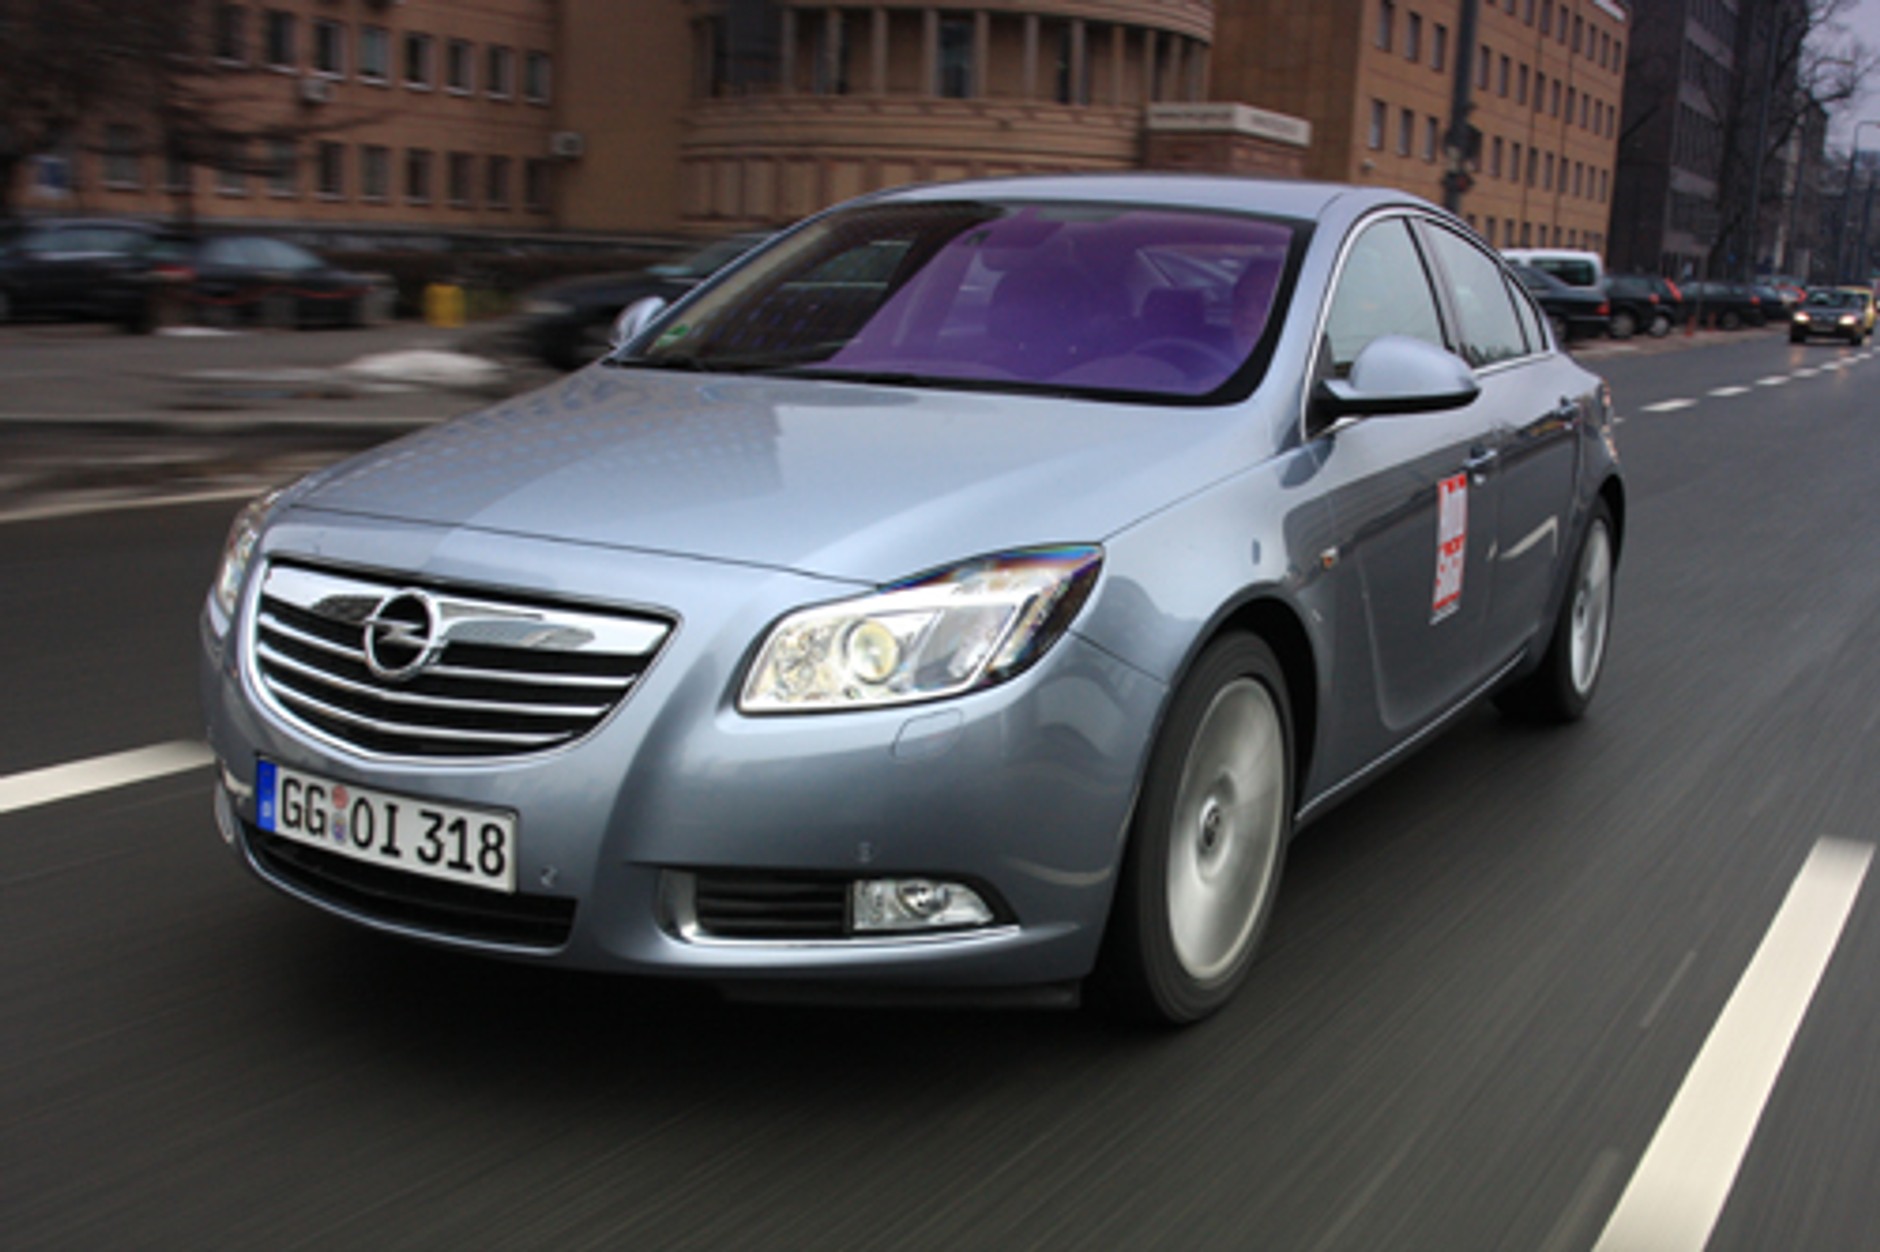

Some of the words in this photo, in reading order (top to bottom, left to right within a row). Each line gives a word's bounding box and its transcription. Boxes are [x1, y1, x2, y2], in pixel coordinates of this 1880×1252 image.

[281, 776, 326, 837] GG
[351, 797, 402, 858] OI
[416, 808, 505, 877] 318
